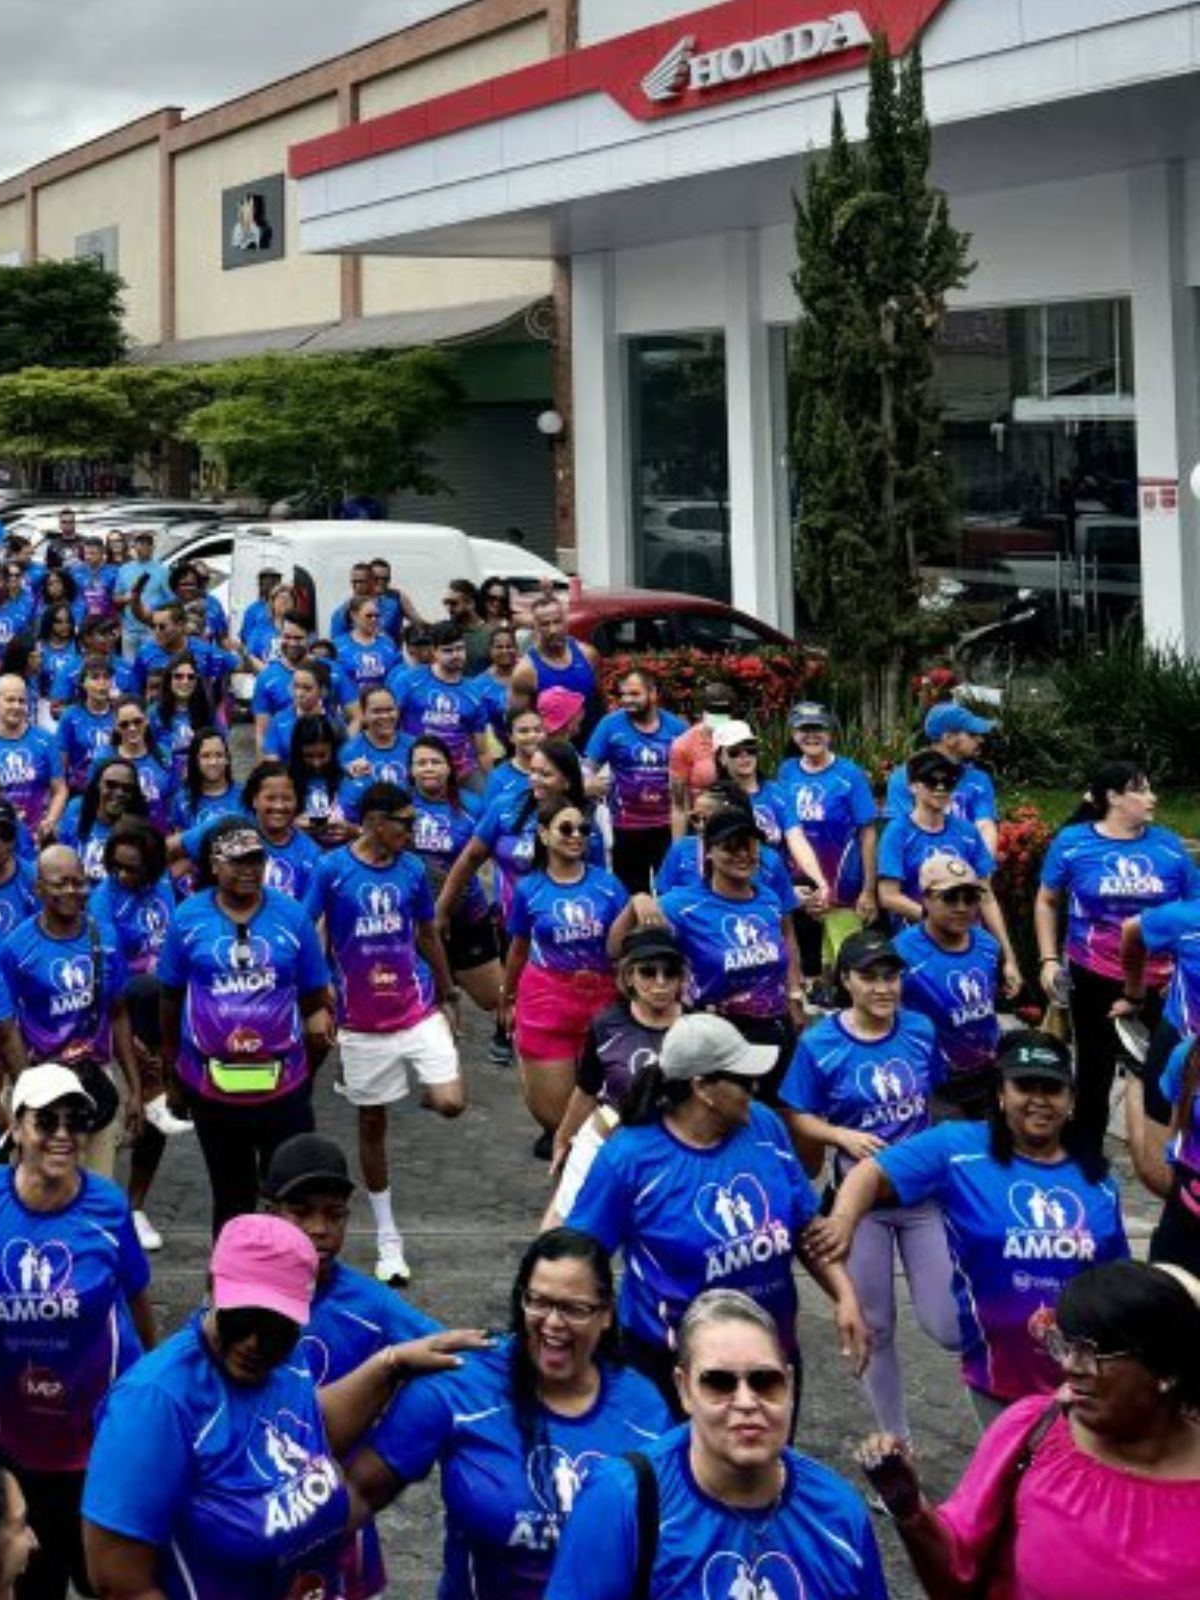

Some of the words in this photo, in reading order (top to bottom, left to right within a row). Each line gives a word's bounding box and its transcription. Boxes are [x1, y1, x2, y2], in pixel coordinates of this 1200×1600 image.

[688, 9, 873, 90] HONDA
[724, 941, 778, 972] AMOR
[211, 972, 276, 996] AMOR
[50, 991, 92, 1015] AMO
[861, 1097, 925, 1128] AMOR
[706, 1227, 791, 1282] AMOR
[1003, 1235, 1095, 1260] AMOR
